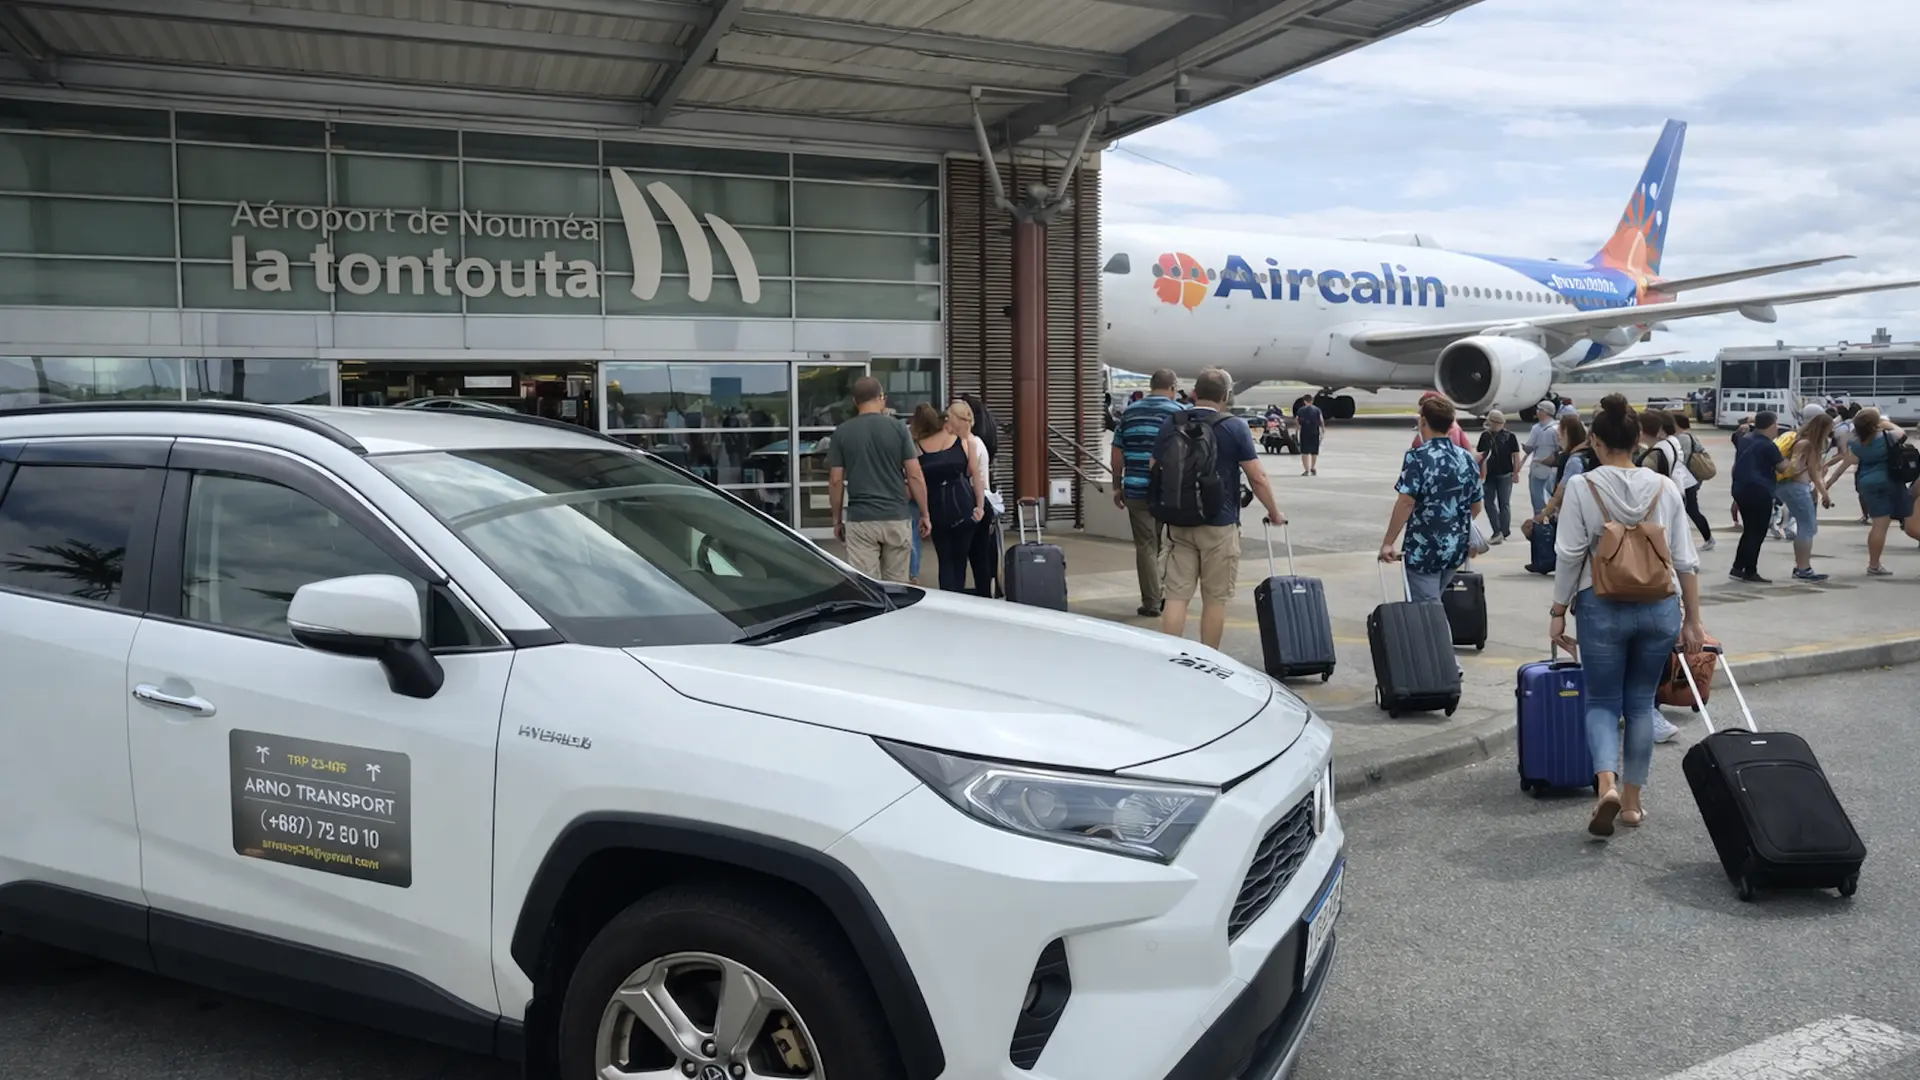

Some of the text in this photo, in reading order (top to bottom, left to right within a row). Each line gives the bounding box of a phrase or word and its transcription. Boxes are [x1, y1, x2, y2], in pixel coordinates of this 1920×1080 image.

[230, 200, 599, 241] Aéroport de Nouméa
[231, 235, 600, 299] la tontouta
[1214, 254, 1446, 308] Aircalin
[245, 777, 395, 815] ARNO TRANSPORT
[260, 808, 313, 839] (+687)
[317, 821, 335, 841] 72
[362, 829, 379, 849] 10
